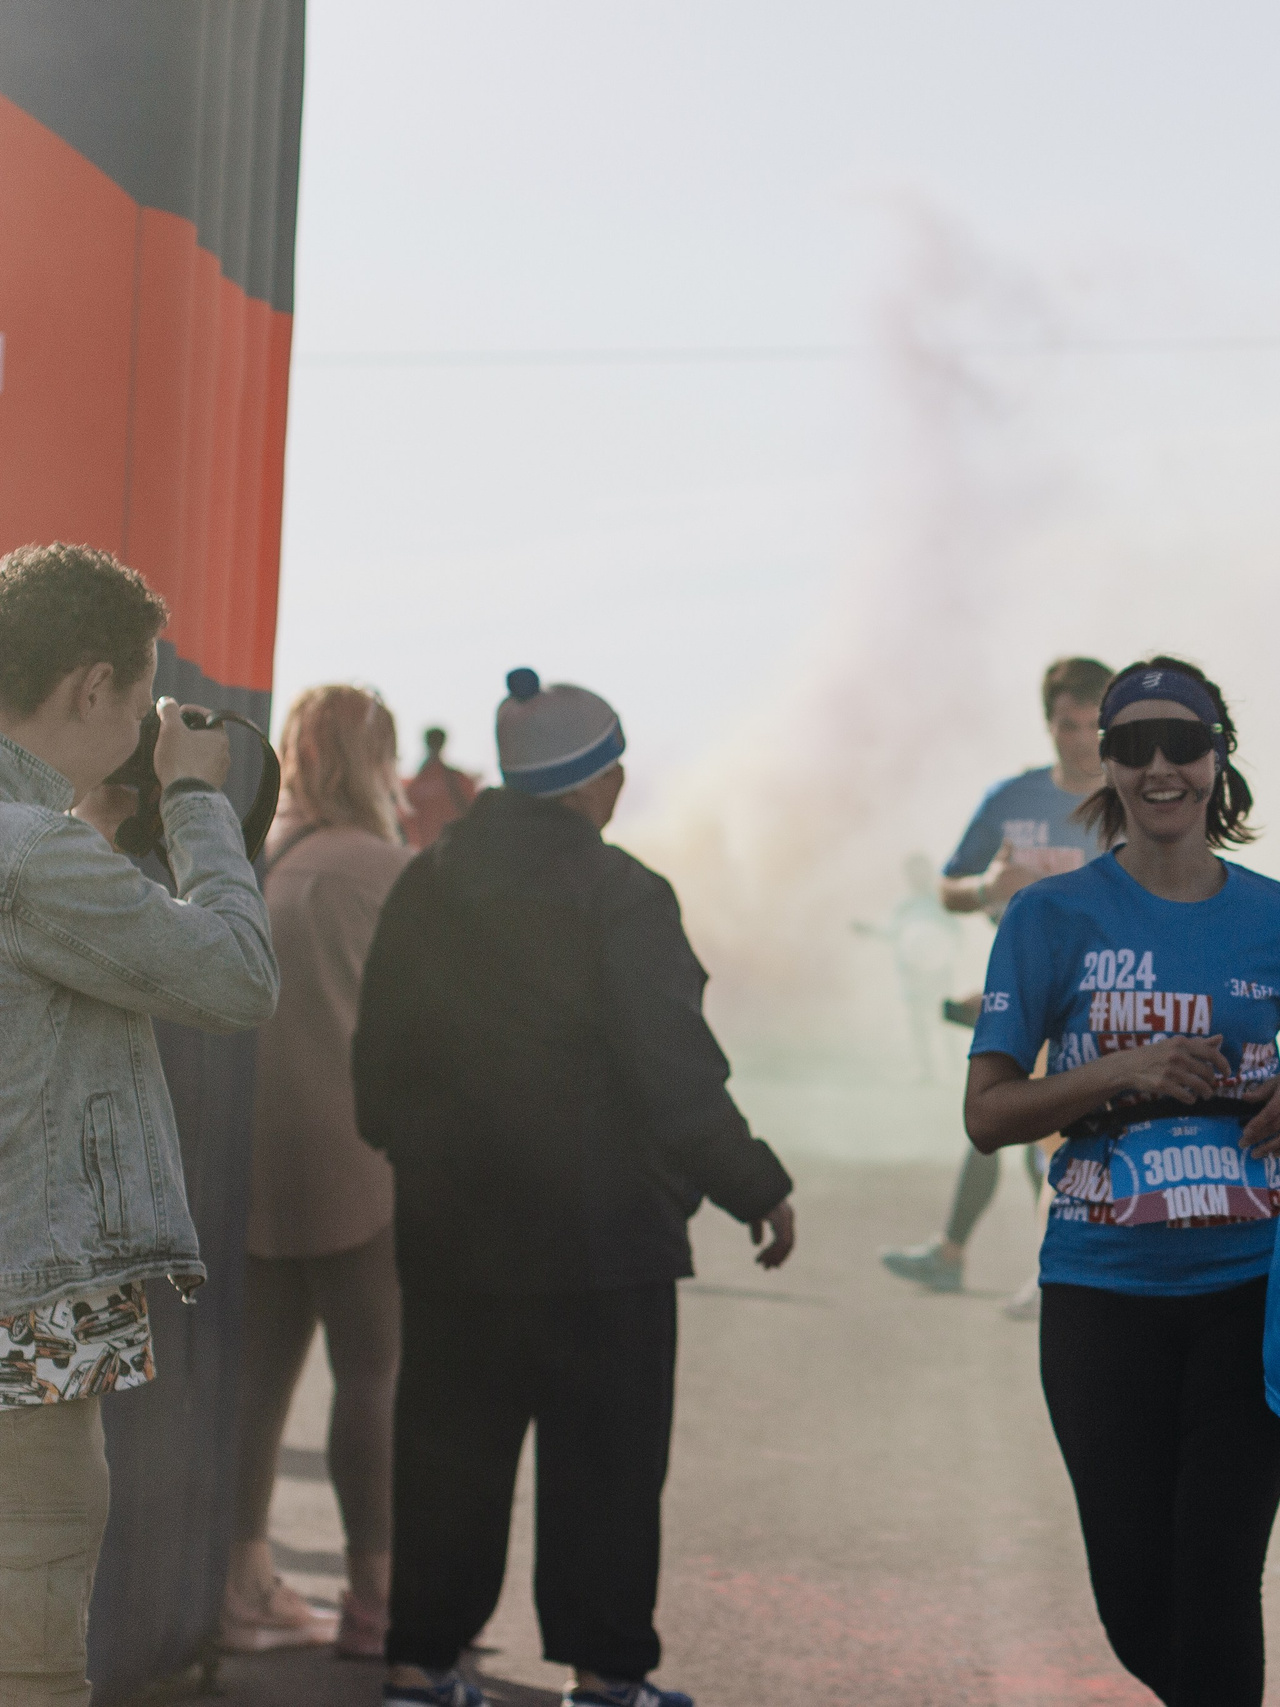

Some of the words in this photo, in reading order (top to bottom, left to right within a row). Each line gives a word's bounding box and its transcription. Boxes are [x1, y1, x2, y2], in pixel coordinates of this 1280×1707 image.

[1079, 949, 1156, 991] 2024
[1088, 992, 1211, 1034] #МЕЧТА
[1143, 1145, 1240, 1186] 30009
